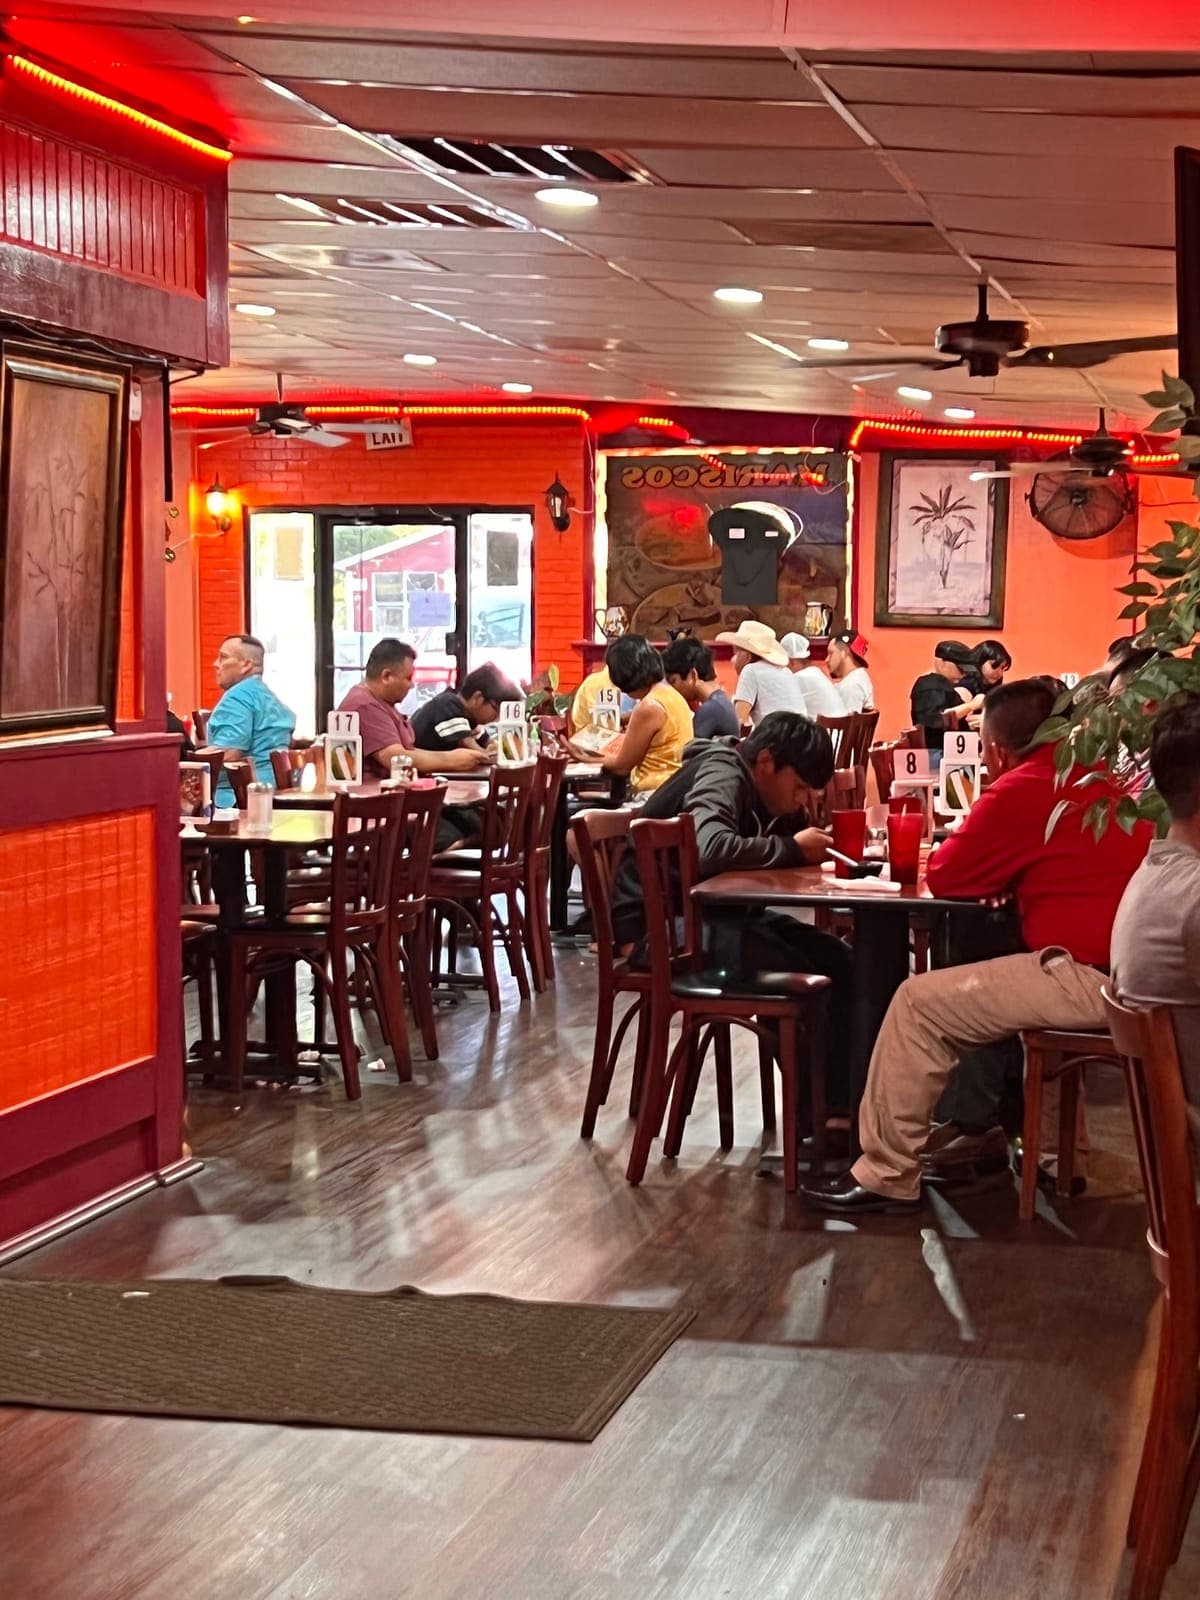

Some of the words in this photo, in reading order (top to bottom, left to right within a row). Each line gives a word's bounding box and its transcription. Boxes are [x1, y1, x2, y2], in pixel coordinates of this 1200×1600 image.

[600, 688, 614, 702] 15
[504, 703, 521, 719] 16
[335, 714, 353, 732] 17
[956, 734, 966, 754] 9
[906, 751, 917, 774] 8
